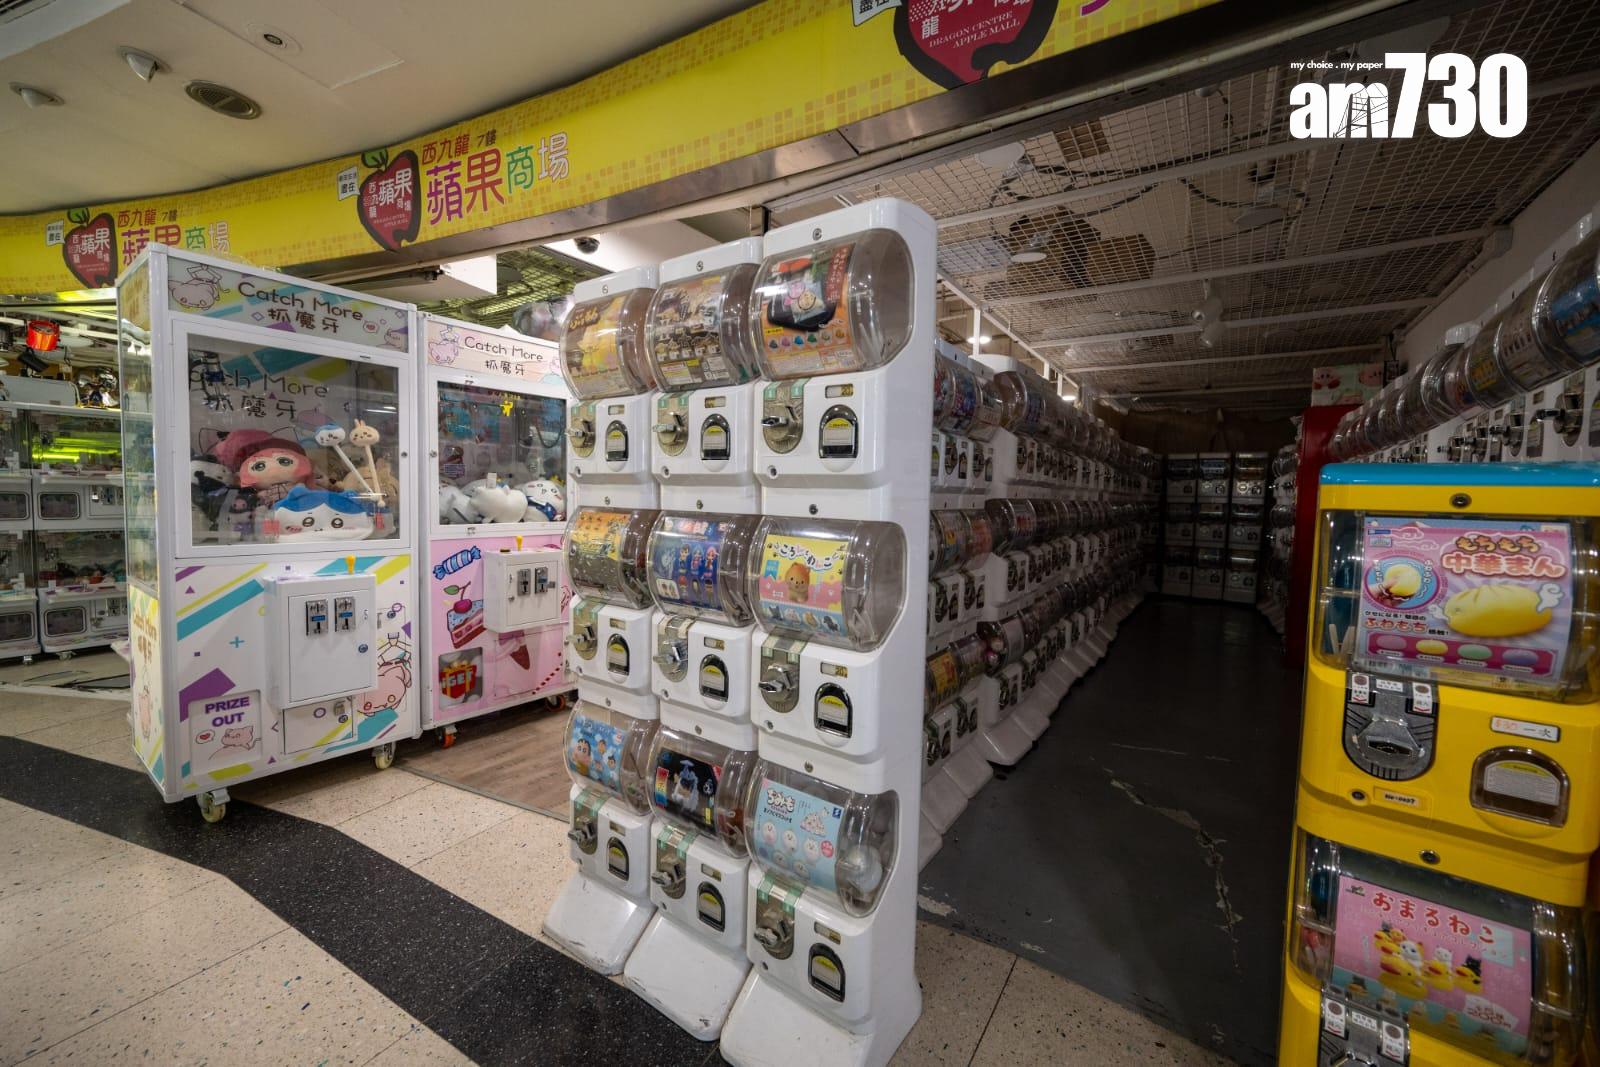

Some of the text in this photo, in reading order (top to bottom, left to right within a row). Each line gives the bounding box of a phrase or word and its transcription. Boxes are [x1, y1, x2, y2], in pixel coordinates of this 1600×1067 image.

[929, 10, 1014, 48] DRAGON CENTRE
[953, 19, 1021, 49] APPLE MALL
[422, 128, 497, 166] 西九龍 7樓
[378, 167, 412, 207] 蘋果
[117, 208, 157, 228] 西九龍
[81, 228, 111, 256] 蘋果
[238, 281, 364, 321] Catch More
[267, 307, 340, 334] 抓魔牙
[464, 336, 544, 361] Catch More
[485, 359, 525, 376] 抓魔牙
[263, 373, 329, 398] More
[1456, 534, 1541, 553] もちもち
[1441, 551, 1566, 579] 中華まん
[1364, 617, 1429, 634] ふわもち
[205, 696, 251, 715] PRIZE
[211, 711, 245, 728] OUT
[1372, 891, 1495, 945] おまるねこ
